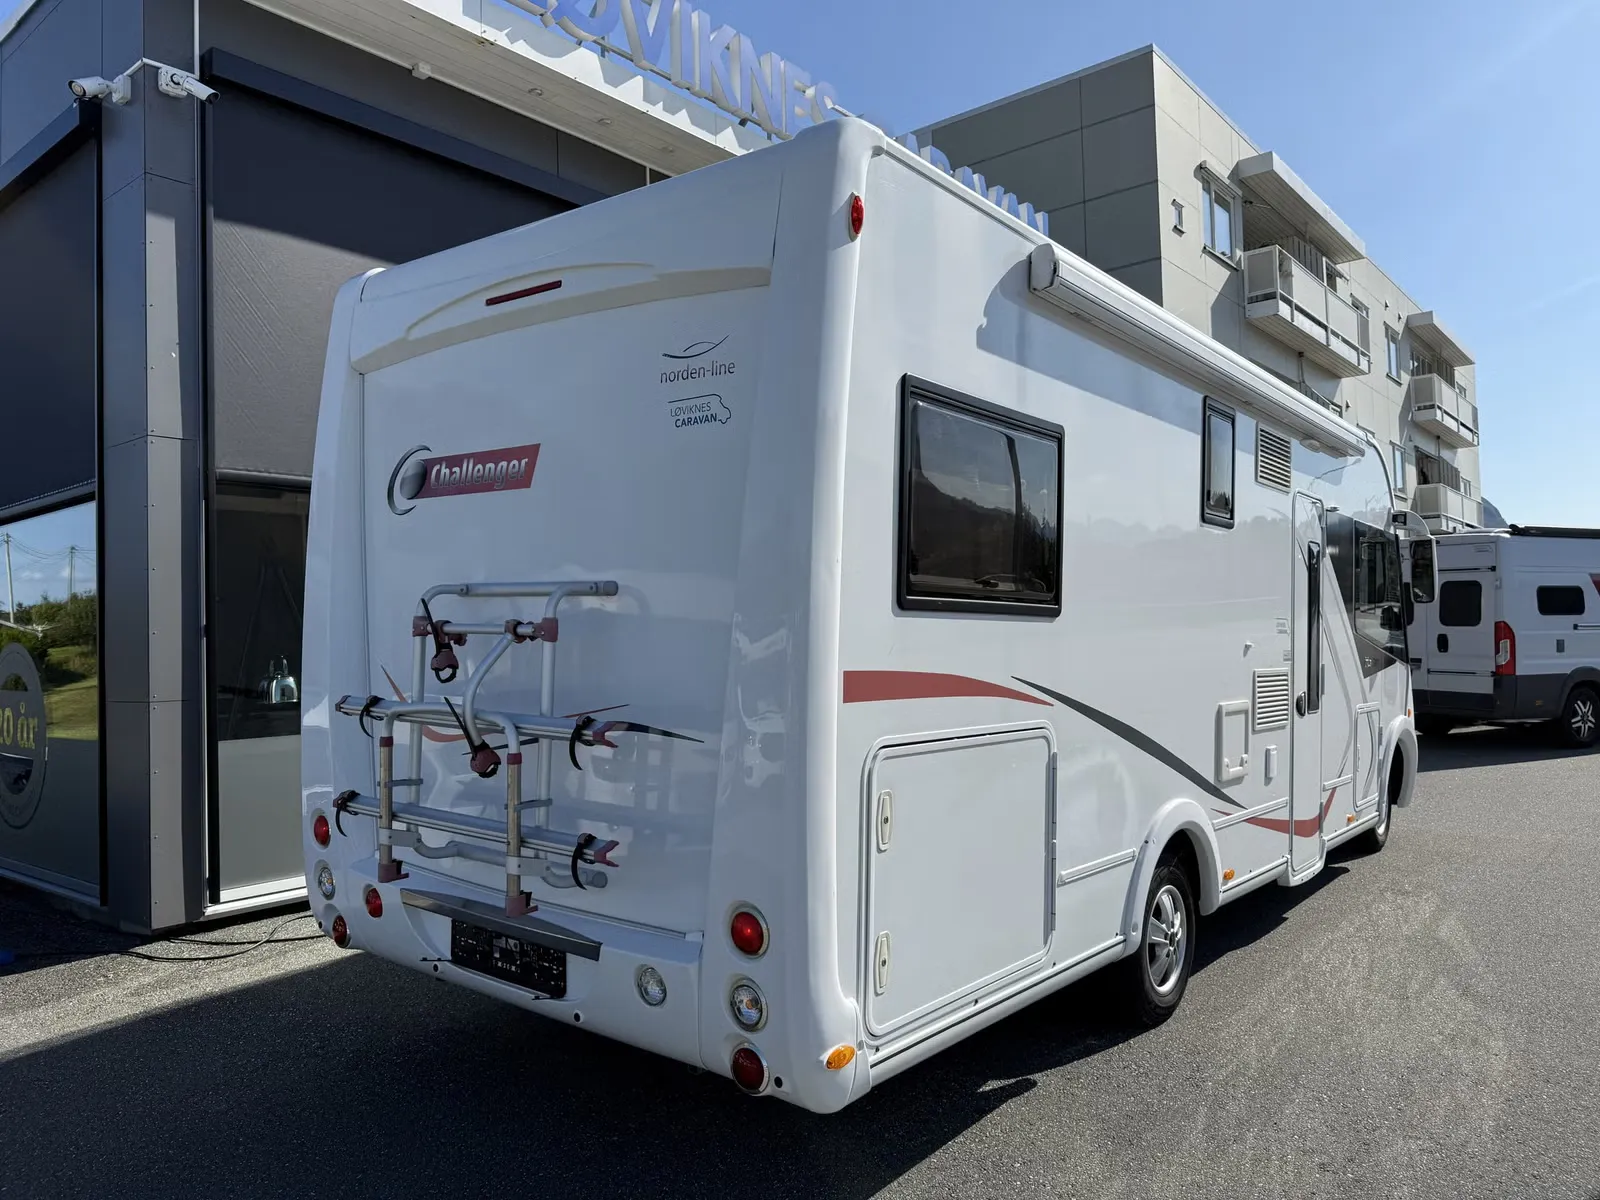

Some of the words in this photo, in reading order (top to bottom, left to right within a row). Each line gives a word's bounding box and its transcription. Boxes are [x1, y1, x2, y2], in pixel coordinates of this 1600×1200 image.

[660, 360, 736, 384] norden-line
[670, 401, 712, 418] LØVIKNES
[674, 413, 718, 428] CARAVAN
[430, 458, 529, 489] Challenger
[0, 707, 14, 746] 0
[17, 702, 38, 749] år
